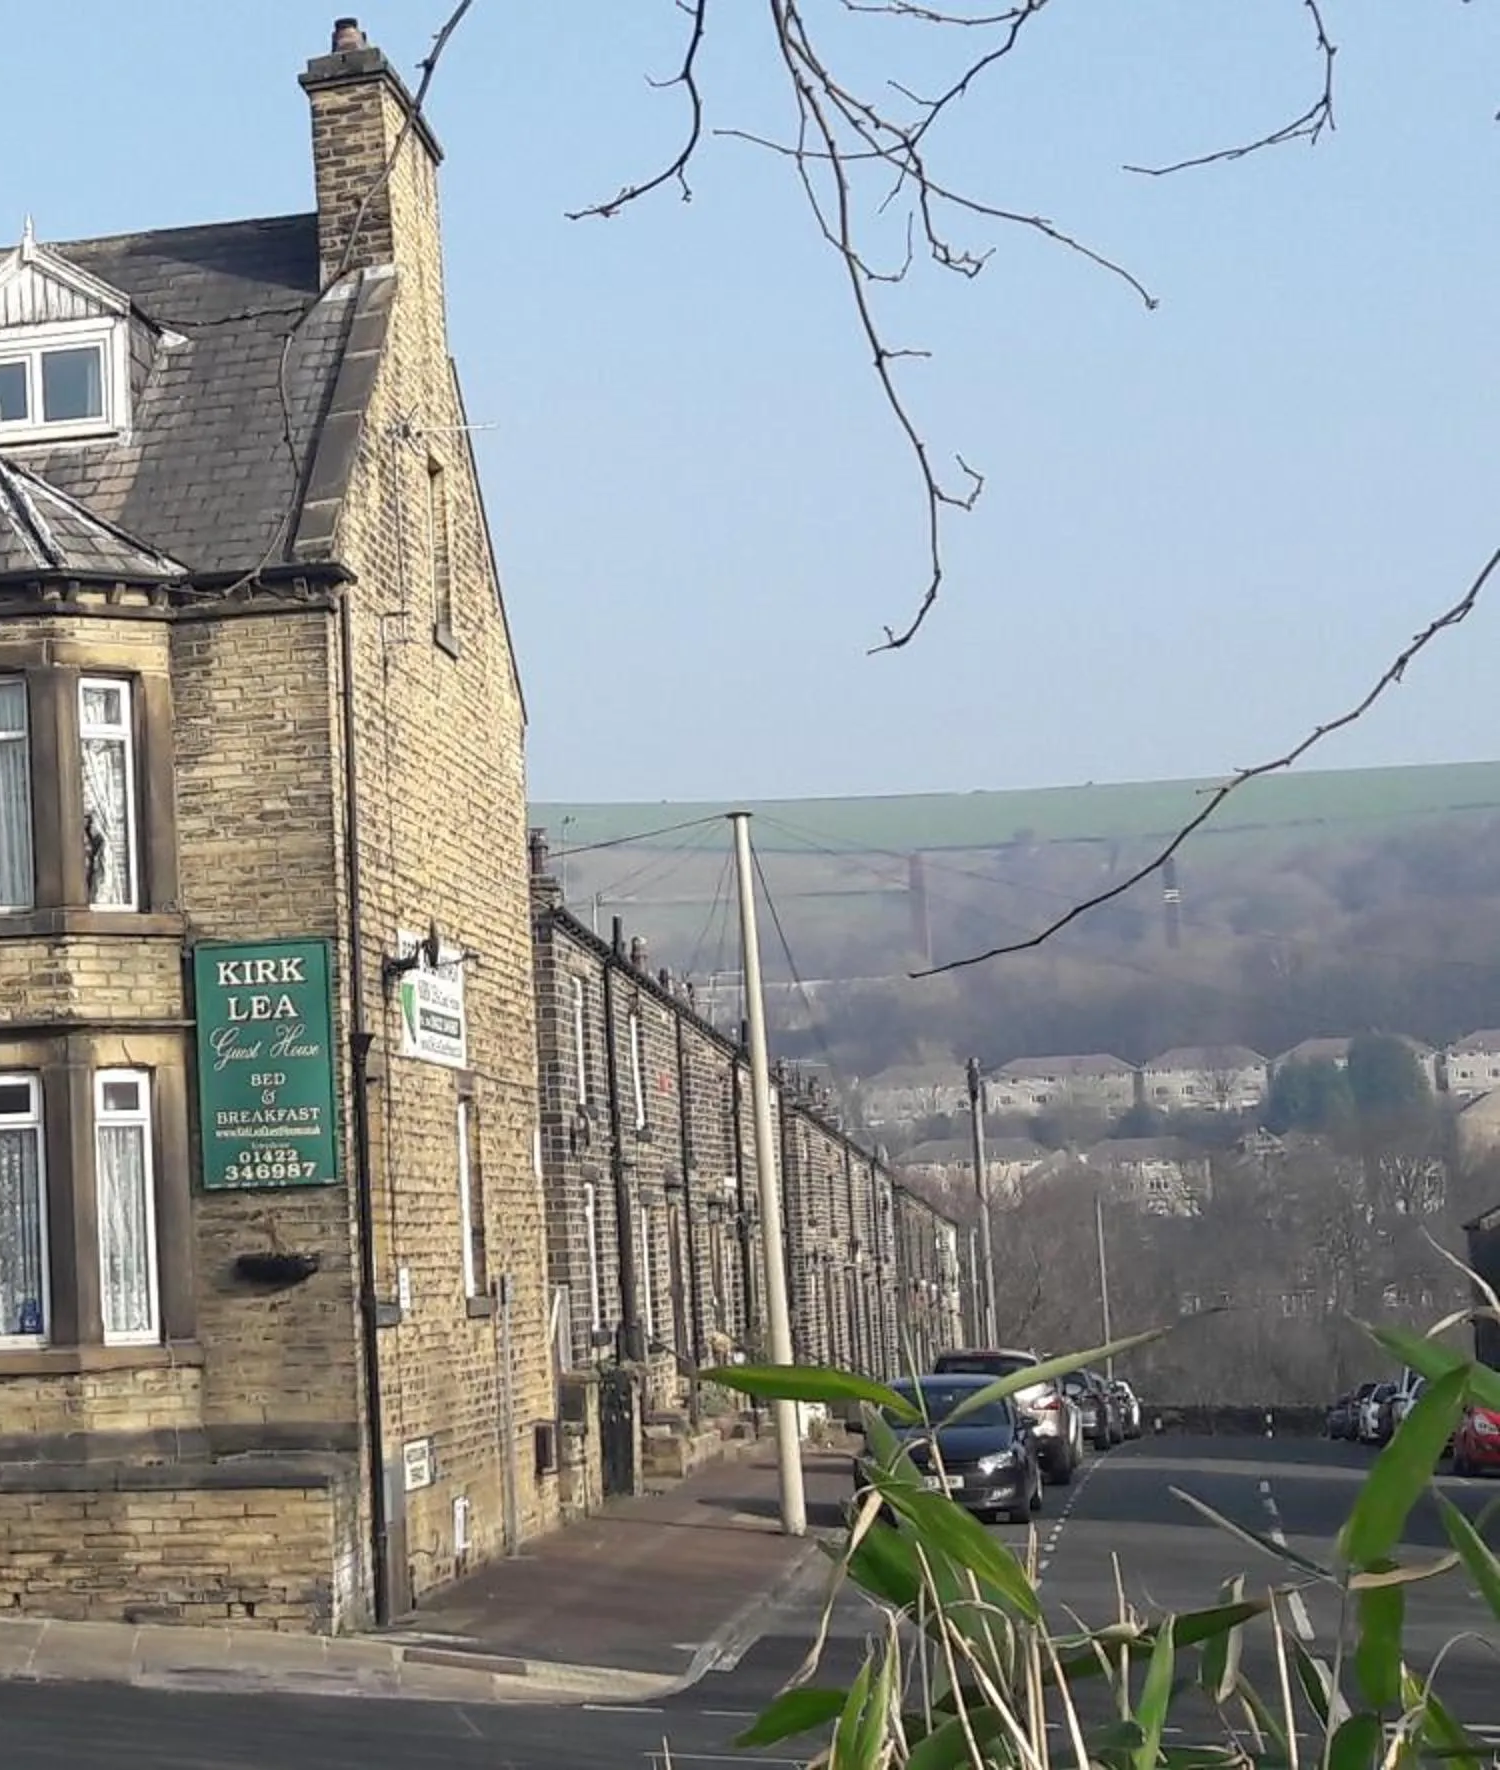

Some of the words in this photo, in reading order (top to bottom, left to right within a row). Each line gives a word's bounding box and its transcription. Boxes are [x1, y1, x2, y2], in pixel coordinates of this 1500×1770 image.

[217, 958, 305, 986] KIRK
[228, 995, 298, 1021] LEA
[210, 1027, 261, 1070] Guest
[270, 1024, 320, 1058] House
[251, 1073, 285, 1087] BED
[261, 1090, 276, 1104] &
[217, 1108, 320, 1125] BREAKFAST
[239, 1150, 299, 1163] 01422
[225, 1163, 317, 1181] 346987
